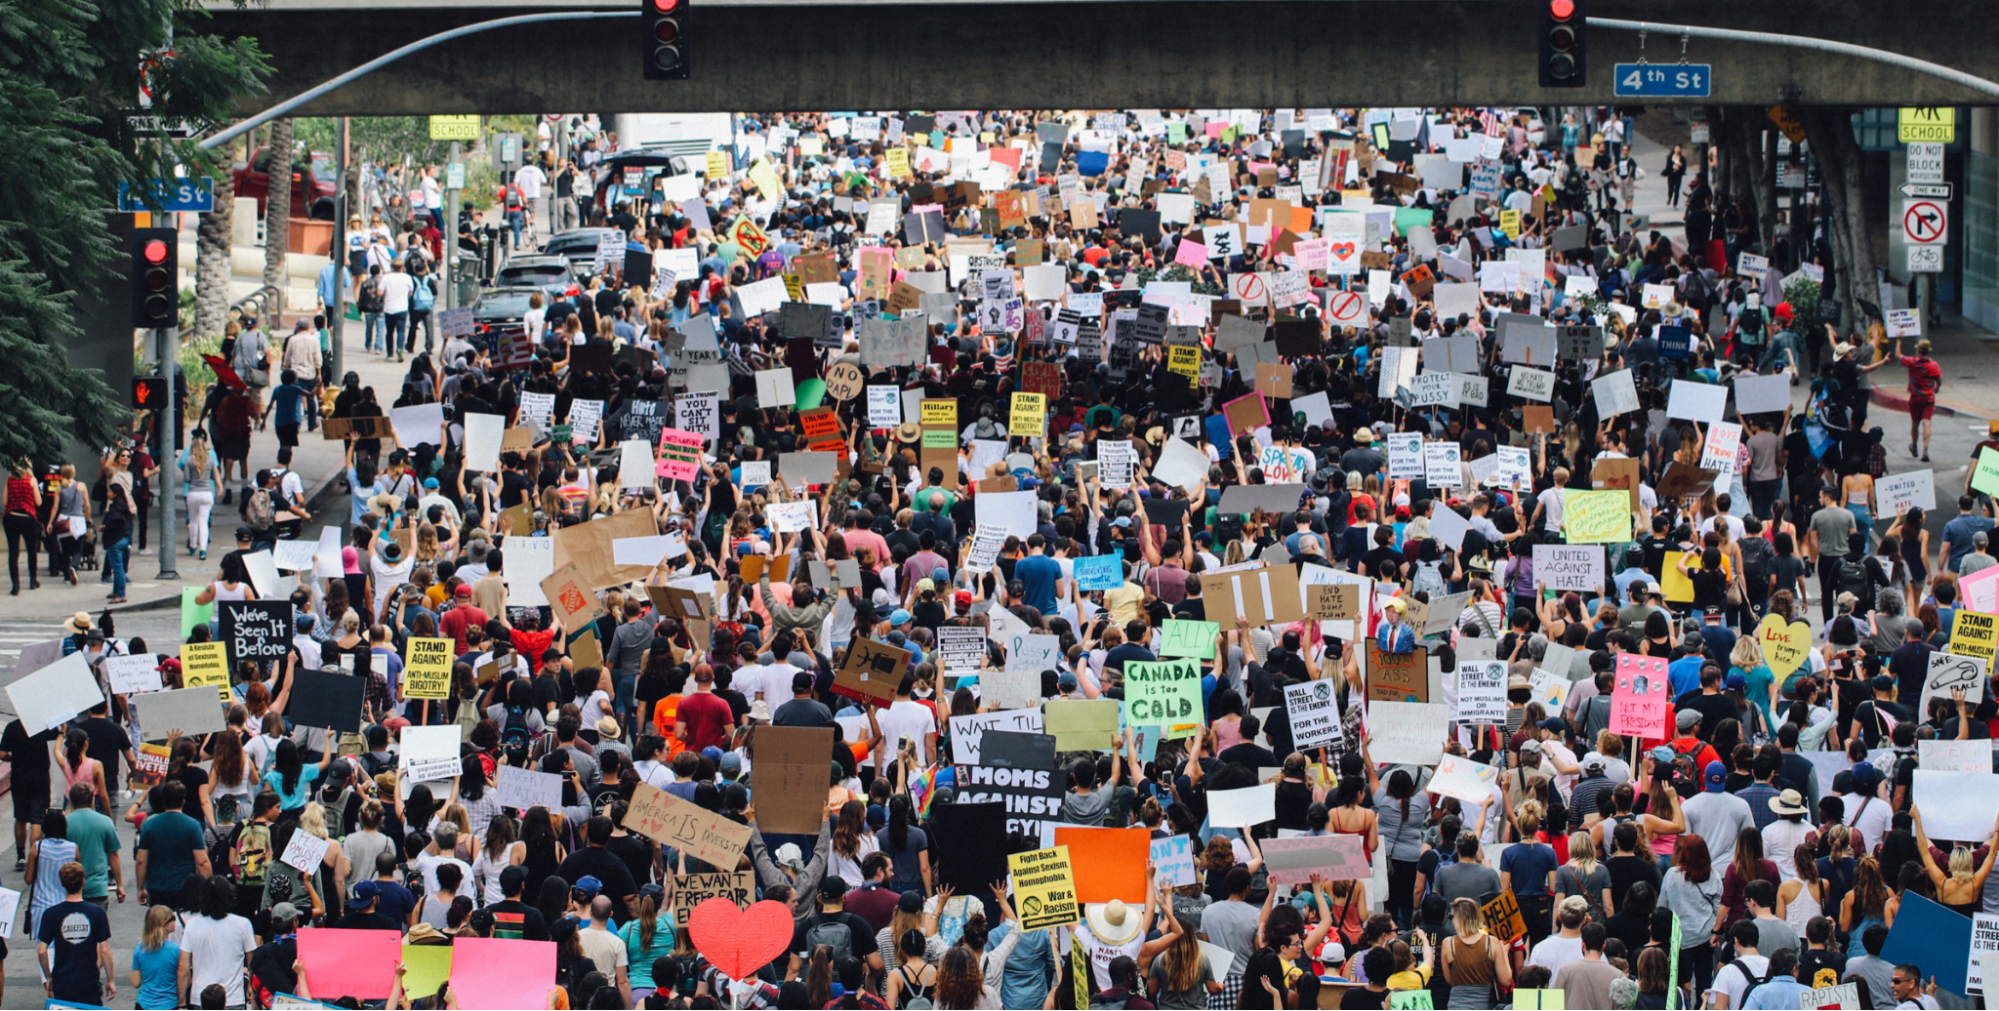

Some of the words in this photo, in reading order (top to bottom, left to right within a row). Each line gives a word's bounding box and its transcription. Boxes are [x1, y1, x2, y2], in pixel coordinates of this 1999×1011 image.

[1622, 70, 1665, 90] 4th
[1675, 72, 1702, 90] St
[434, 125, 476, 137] SCHOOL
[1903, 126, 1950, 139] SCHOOL
[1910, 145, 1922, 156] DO
[1926, 145, 1942, 156] NOT
[1910, 160, 1941, 171] BLOCK
[1910, 172, 1941, 180] INTERSECTION
[178, 186, 204, 203] St
[1932, 187, 1947, 195] WAY
[969, 255, 1004, 268] OBSTRUCT
[1661, 340, 1687, 350] THINK
[688, 350, 717, 360] YEARS
[1174, 348, 1196, 358] STAND
[1025, 362, 1057, 375] CIVIL
[1172, 357, 1197, 367] AGAINST
[834, 366, 858, 382] NO
[1023, 374, 1059, 387] RIGHTS
[1411, 373, 1450, 386] PROTECT
[1520, 369, 1529, 379] NO
[1530, 371, 1544, 382] HATE
[827, 379, 854, 399] DAPL
[1421, 383, 1441, 391] YOUR
[1517, 378, 1525, 387] NO
[694, 391, 718, 399] TRUMP
[1017, 394, 1040, 403] STAND
[1413, 390, 1449, 404] PUSSY
[685, 400, 708, 409] YOU
[923, 402, 955, 412] Hillary
[1014, 403, 1041, 412] AGAINST
[681, 408, 712, 418] CAN'T
[804, 414, 829, 423] TRUMP
[1012, 415, 1043, 423] ANTI-MUSLIM
[620, 413, 644, 428] NEVER
[645, 415, 665, 426] MADE
[688, 417, 706, 426] SIT
[1013, 422, 1040, 431] BIGOTRY!
[685, 424, 710, 433] WITH
[1710, 425, 1741, 445] LOVE
[1707, 442, 1737, 460] TRUMPS
[1703, 457, 1731, 474] HATE
[1888, 480, 1916, 492] UNITED
[1894, 500, 1912, 510] HATE
[1552, 549, 1591, 562] UNITED
[1079, 564, 1113, 574] SURVIVING
[1544, 562, 1592, 575] AGAINST
[1556, 575, 1587, 588] HATE
[1323, 585, 1340, 595] END
[1319, 594, 1343, 603] HATE
[228, 605, 269, 623] We've
[1317, 611, 1346, 619] TRUMP
[1961, 613, 1993, 628] STAND
[234, 622, 269, 637] Seen
[269, 618, 287, 637] It
[1957, 626, 1994, 641] AGAINST
[1167, 621, 1219, 650] ALLY
[1766, 627, 1792, 643] LOVE
[194, 643, 216, 651] Resistir
[234, 637, 287, 658] Before
[415, 641, 446, 652] STAND
[1776, 642, 1801, 658] trumps
[1951, 641, 1995, 657] ANTI-MUSLIM
[188, 653, 194, 661] el
[411, 653, 447, 665] AGAINST
[1774, 650, 1793, 665] hate
[1931, 657, 1954, 669] SAFE
[407, 670, 449, 680] ANTI-MUSLIM
[1128, 661, 1198, 683] CANADA
[1461, 665, 1479, 673] WALL
[205, 674, 222, 682] Guerra
[1382, 668, 1411, 684] ASS
[1460, 672, 1485, 681] STREET
[409, 680, 445, 691] BIGOTRY!
[1145, 680, 1156, 695] is
[1160, 682, 1179, 695] too
[1460, 681, 1467, 689] IS
[1467, 680, 1478, 689] THE
[1478, 680, 1503, 689] ENEMY.
[1949, 681, 1979, 692] PLACE
[1287, 687, 1307, 699] WALL
[1376, 688, 1388, 697] BAD
[1287, 695, 1314, 708] STREET
[1460, 696, 1474, 704] NOT
[1474, 696, 1505, 704] MUSLIMS
[1131, 696, 1193, 721] COLD
[1290, 705, 1297, 715] IS
[1297, 703, 1308, 713] THE
[1308, 700, 1333, 711] ENEMY.
[1458, 709, 1505, 717] IMMIGRANTS
[1620, 702, 1636, 714] NOT
[1642, 702, 1660, 714] MY
[955, 717, 1000, 735] WAIT
[1013, 715, 1043, 731] TIL
[1293, 719, 1312, 731] FOR
[1312, 715, 1330, 727] THE
[1296, 725, 1340, 741] WORKERS
[138, 752, 171, 765] DONALD
[501, 766, 548, 787] ANGRY
[971, 766, 1051, 789] MOMS
[500, 782, 560, 804] FEMINIST
[632, 798, 677, 827] AMERICA
[673, 813, 699, 840] IS
[700, 827, 745, 855] DIVERSITY
[721, 823, 738, 836] HATE
[293, 844, 316, 863] MUST
[1019, 851, 1039, 865] Fight
[1038, 848, 1058, 861] Back
[291, 855, 308, 869] GO
[1013, 863, 1039, 878] Against
[675, 874, 697, 889] WE
[701, 872, 747, 888] WANT
[1047, 889, 1064, 902] War
[1065, 889, 1074, 900] &
[1043, 900, 1076, 915] Racism
[1178, 905, 1189, 914] up
[1481, 895, 1520, 928] HELL
[1976, 919, 1999, 929] WALL
[1975, 930, 1999, 941] STREE
[1098, 945, 1124, 956] NASTY
[1974, 940, 1980, 949] IS
[1980, 940, 1996, 950] THE
[1800, 982, 1858, 1008] RAPISTS
